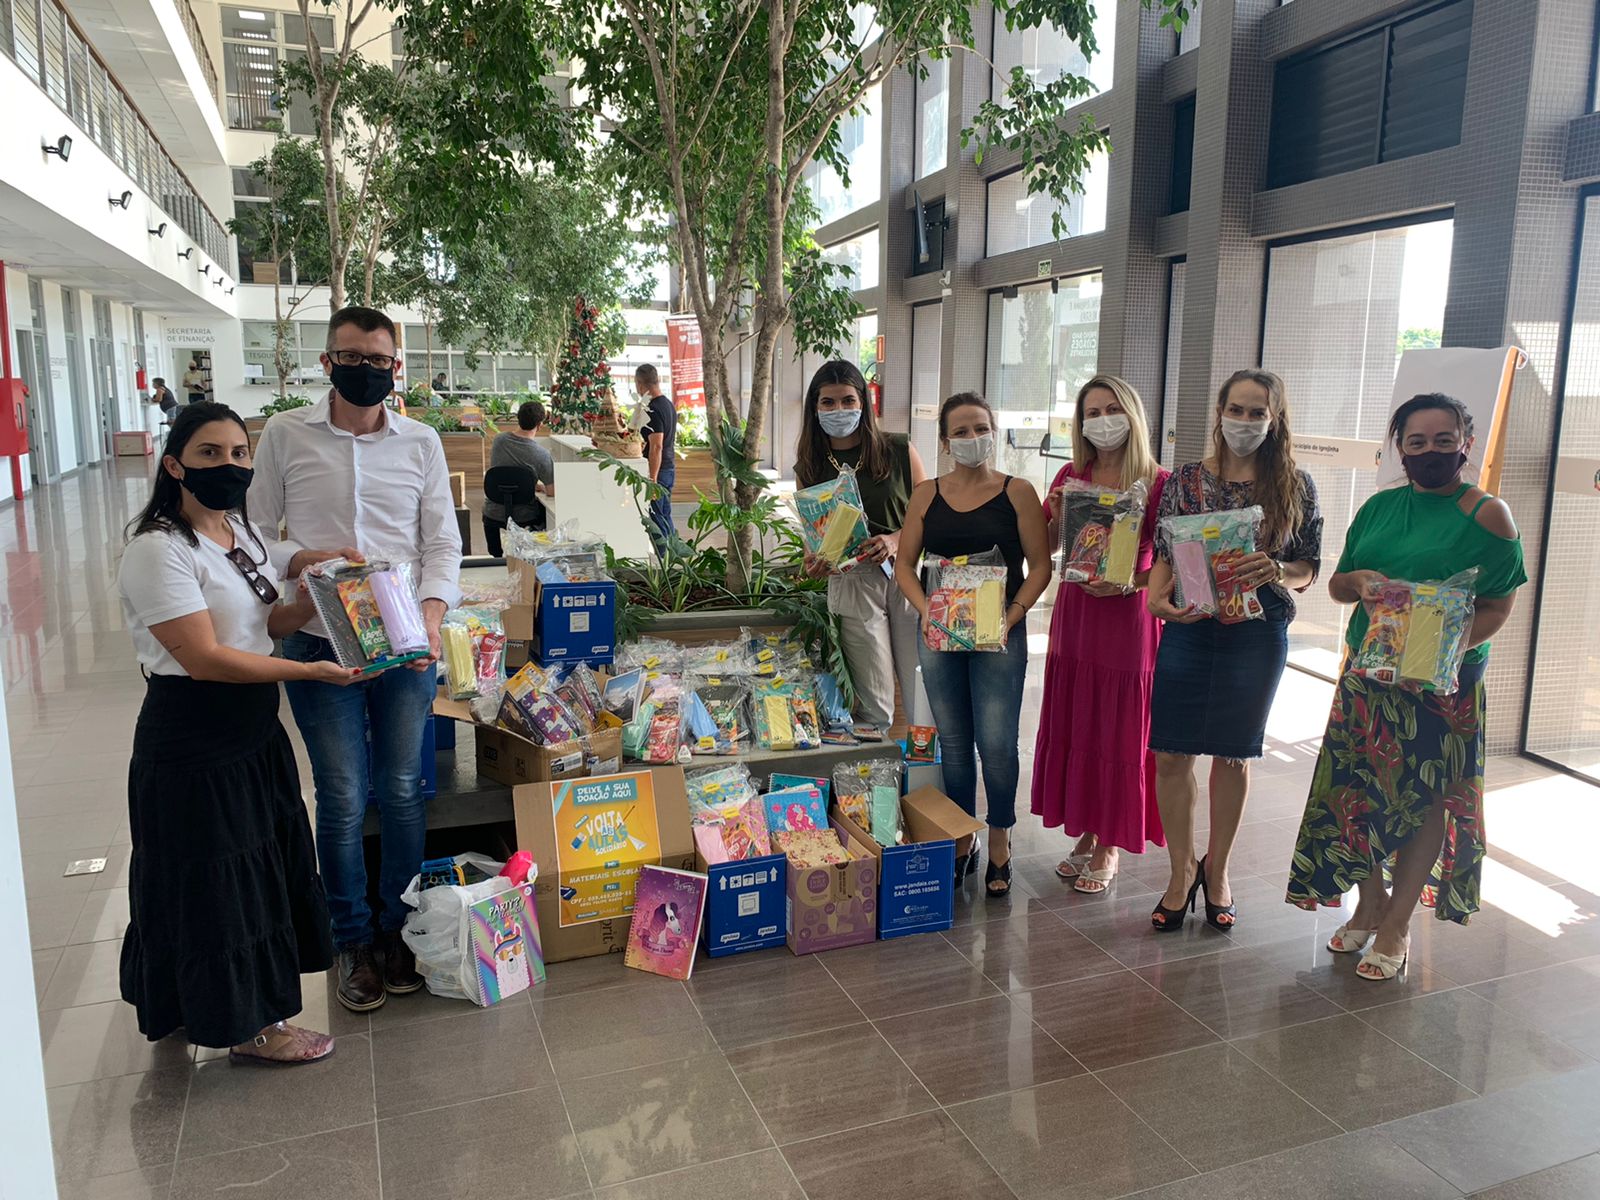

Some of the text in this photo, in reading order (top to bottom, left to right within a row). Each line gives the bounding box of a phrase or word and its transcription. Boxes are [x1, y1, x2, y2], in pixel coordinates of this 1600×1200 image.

[166, 327, 211, 335] SECRETARIA
[1319, 444, 1339, 453] Igrejinha
[577, 782, 630, 795] DEIXE A SUA
[576, 789, 632, 803] DOAÇÃO AQUI
[585, 810, 625, 836] VOLTA
[588, 824, 629, 850] AULAS
[569, 872, 610, 884] MATERIAIS
[893, 879, 940, 890] www.jandaia.com
[893, 889, 907, 897] SAC:
[488, 896, 522, 916] PARTY?
